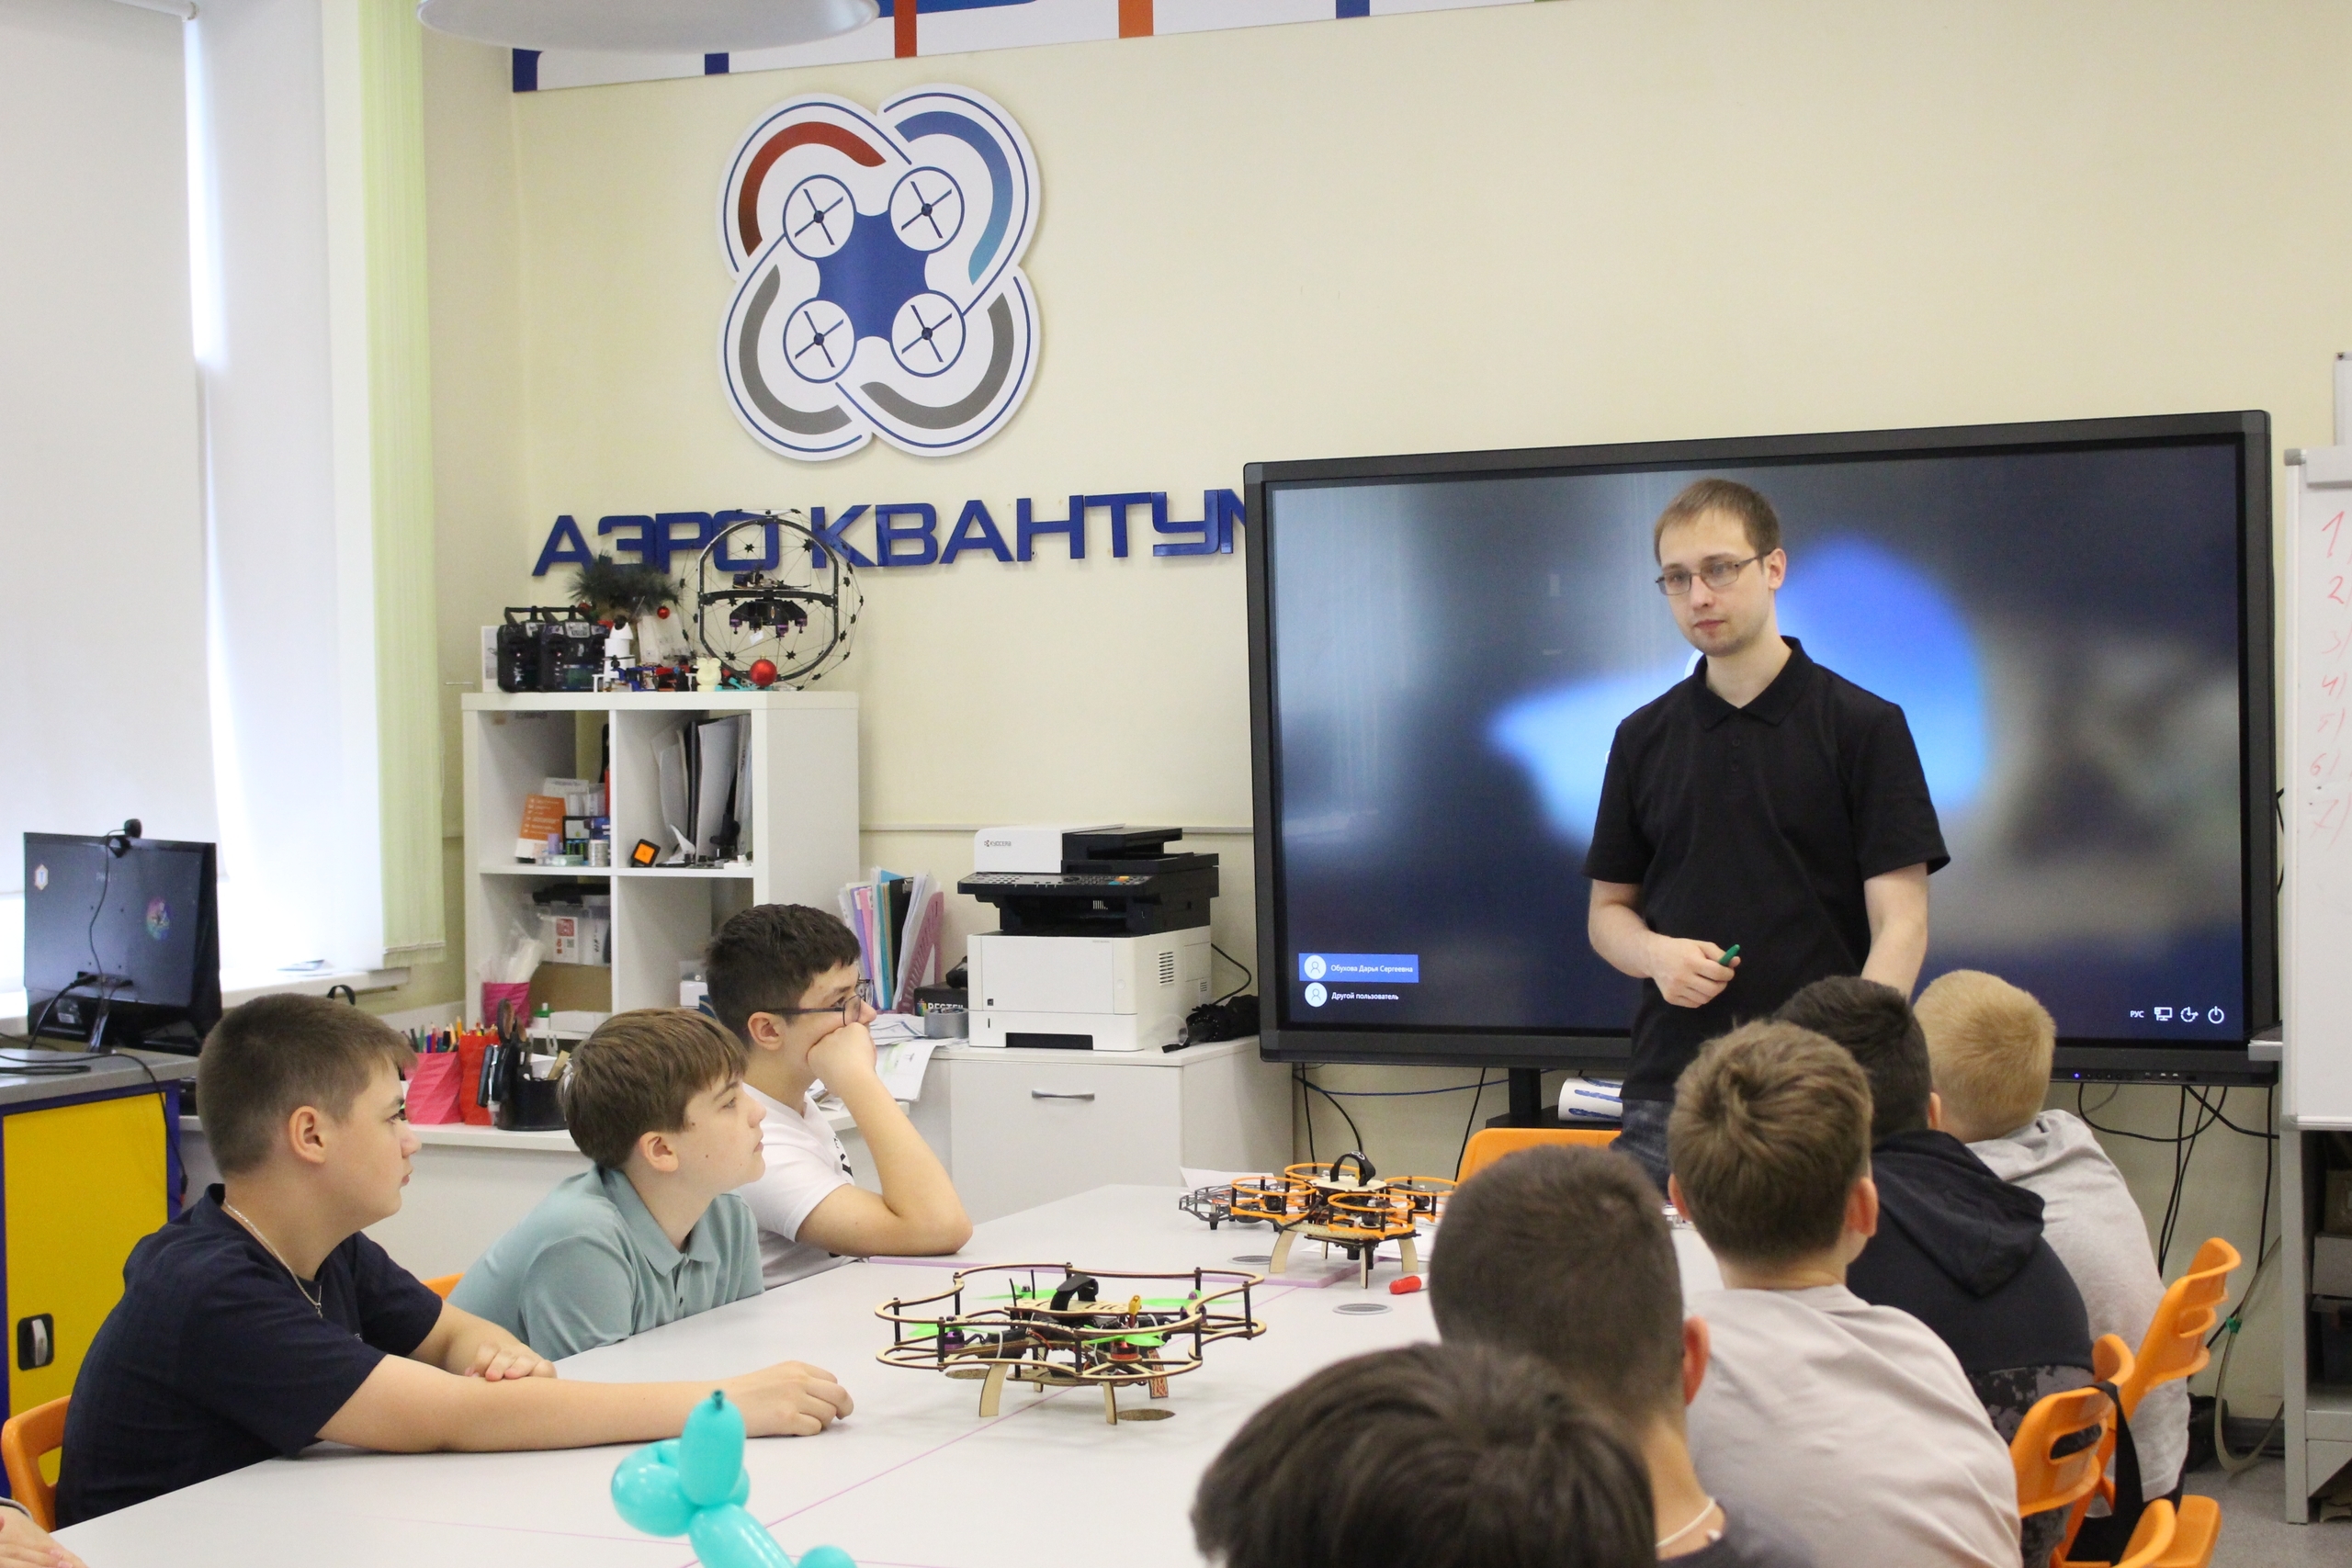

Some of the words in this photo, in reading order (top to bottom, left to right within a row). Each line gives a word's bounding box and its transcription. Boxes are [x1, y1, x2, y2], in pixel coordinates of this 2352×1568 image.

[1330, 964, 1358, 973] Обухова
[1359, 964, 1378, 974] Дарья
[1379, 965, 1413, 974] Сергеевна
[1331, 992, 1355, 1000] Другой
